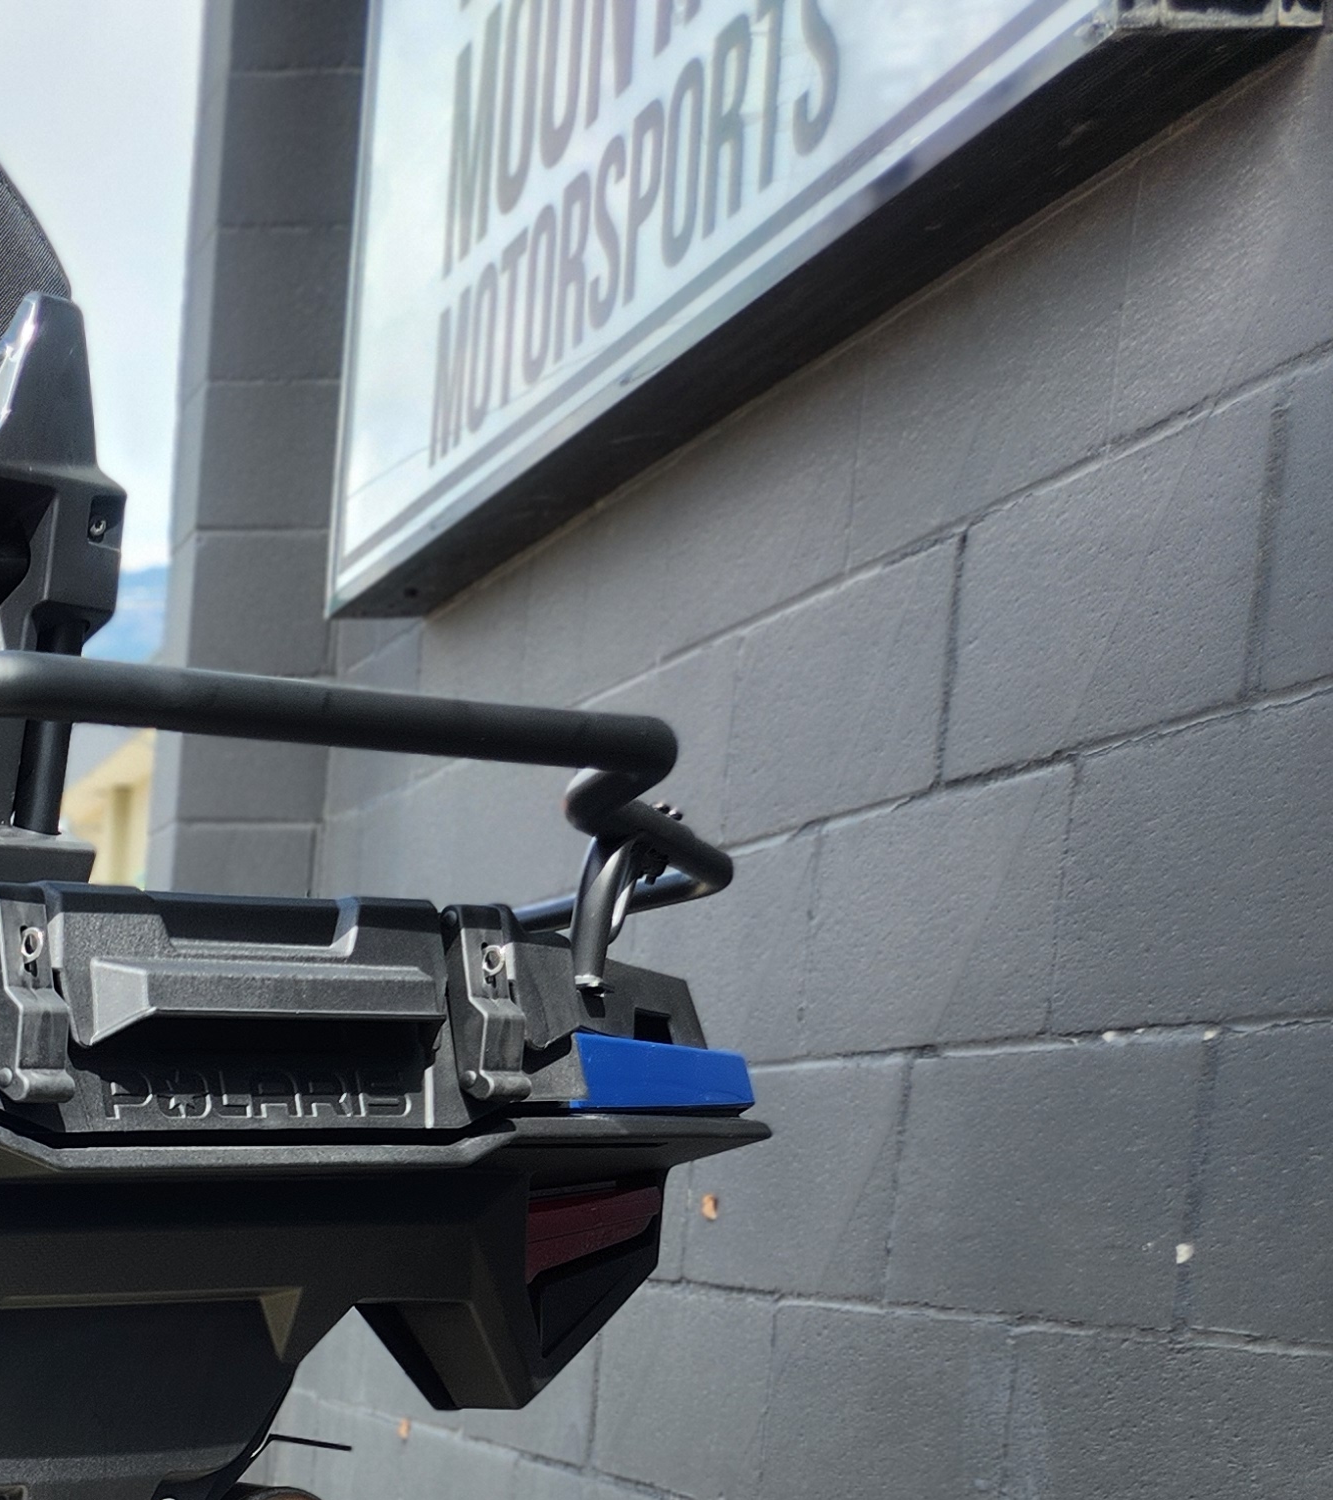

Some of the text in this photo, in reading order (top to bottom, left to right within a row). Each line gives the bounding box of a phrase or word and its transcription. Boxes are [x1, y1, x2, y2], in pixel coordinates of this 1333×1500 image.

[429, 0, 840, 468] MOTORSPORTS
[443, 0, 701, 281] MOUN
[105, 1069, 412, 1119] POLARIS
